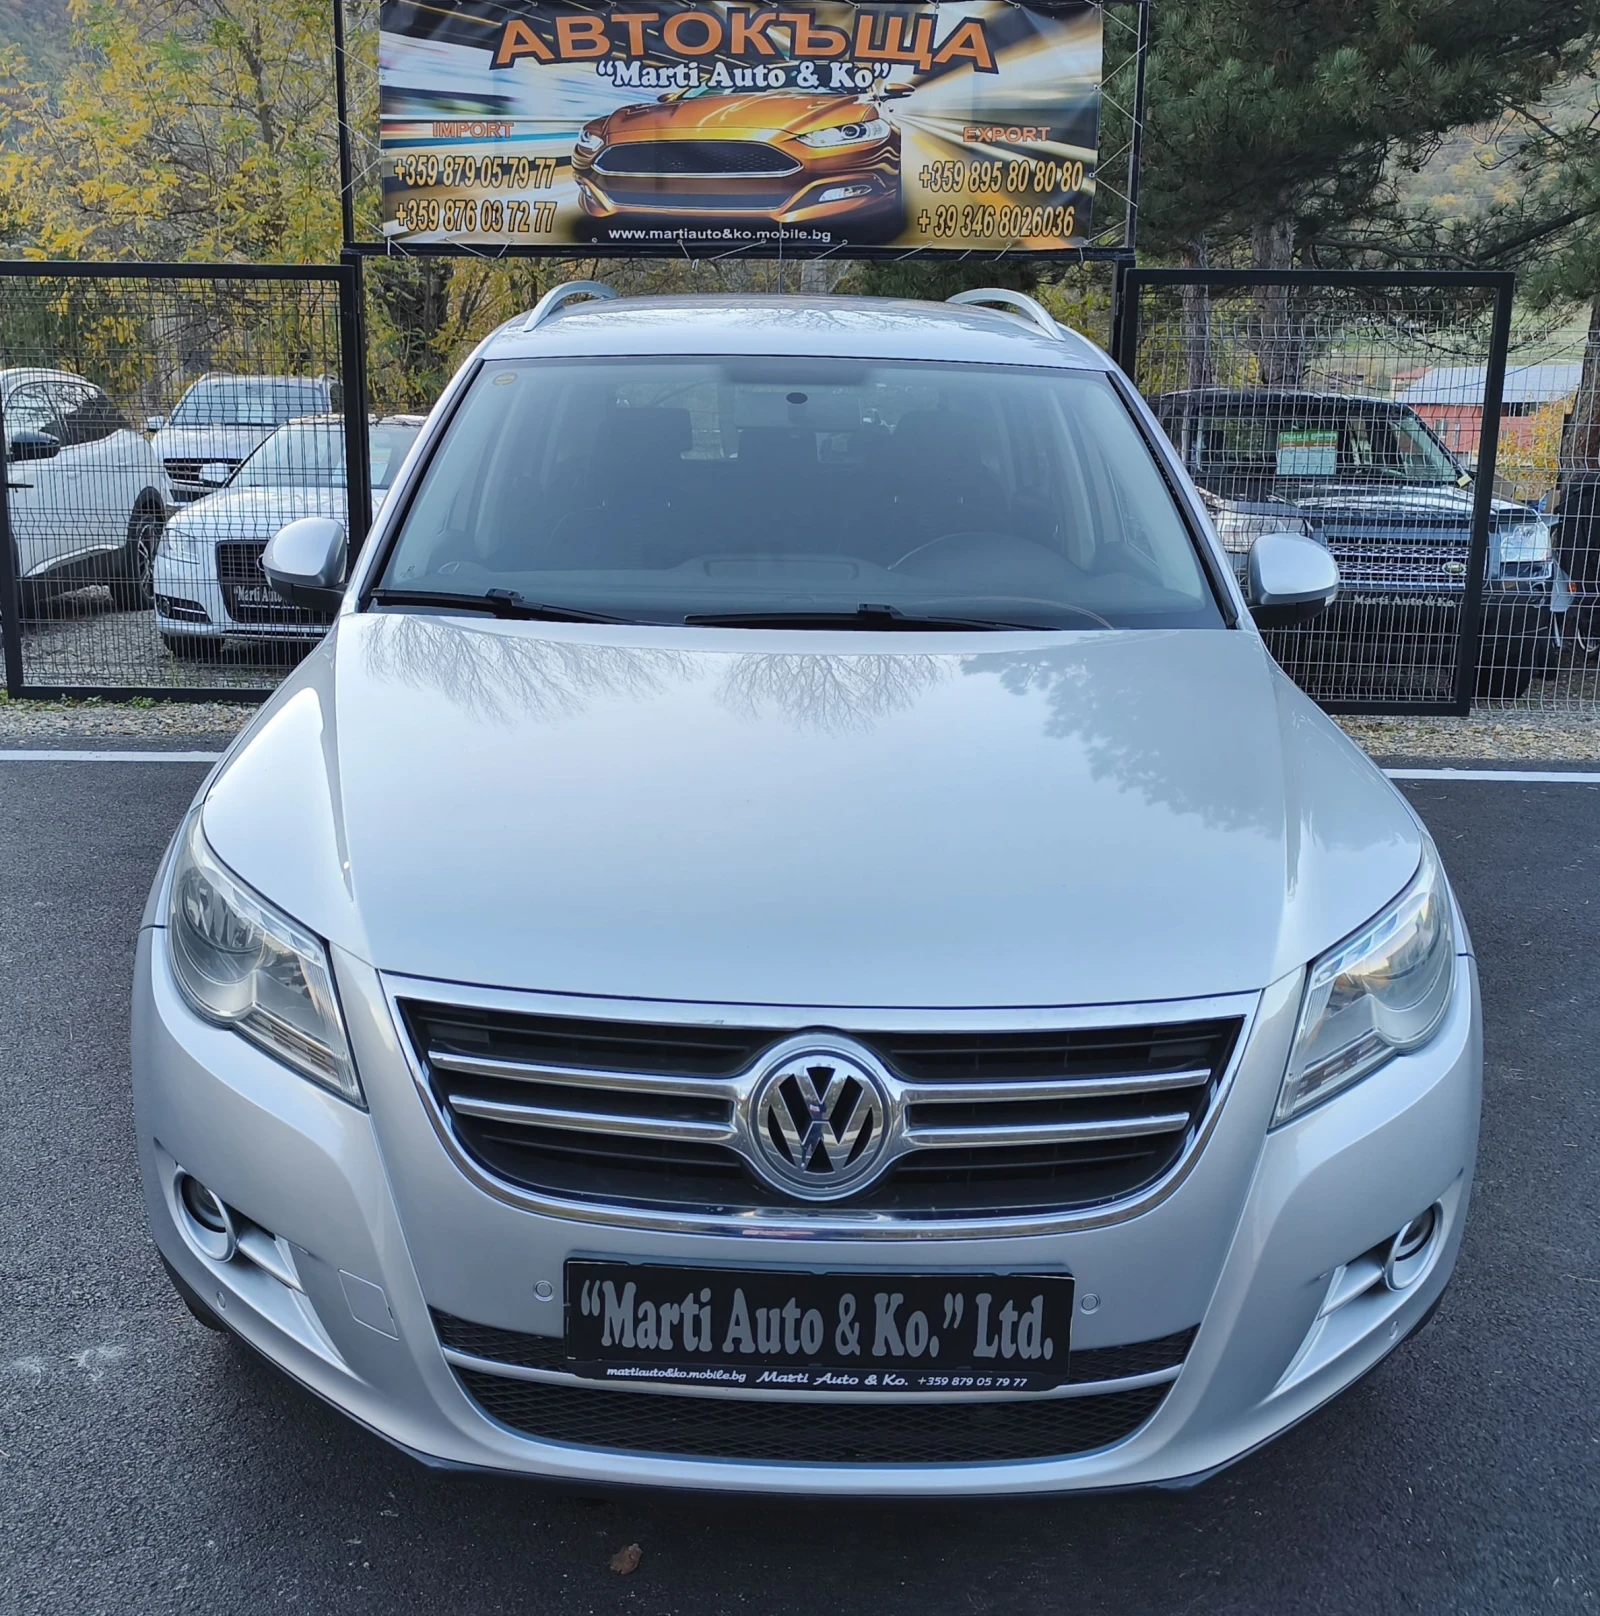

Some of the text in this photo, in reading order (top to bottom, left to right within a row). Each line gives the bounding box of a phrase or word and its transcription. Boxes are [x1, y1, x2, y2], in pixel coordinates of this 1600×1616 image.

[494, 11, 995, 70] АВТОКЪЩА
[598, 61, 890, 88] “Marti Auto & Ko”
[432, 122, 514, 138] IMPORT
[963, 127, 1051, 143] EXPORT
[394, 155, 556, 189] +359 879 05 79 77
[919, 160, 1083, 192] +359 895 80 80 80
[395, 199, 557, 233] +359 876 03 72 77
[918, 205, 1075, 238] + 39 346 8026036
[608, 227, 832, 243] www.martiauto&ko.mobile.bg
[1354, 594, 1388, 605] Marti
[1393, 595, 1423, 606] Auto
[1425, 595, 1435, 606] &
[580, 1279, 1053, 1361] “Marti Auto & Ko.” Ltd.
[606, 1367, 1028, 1388] martiauto&ko.mobile.bg Marti Auto & Ko. +359 879 05 79 77
